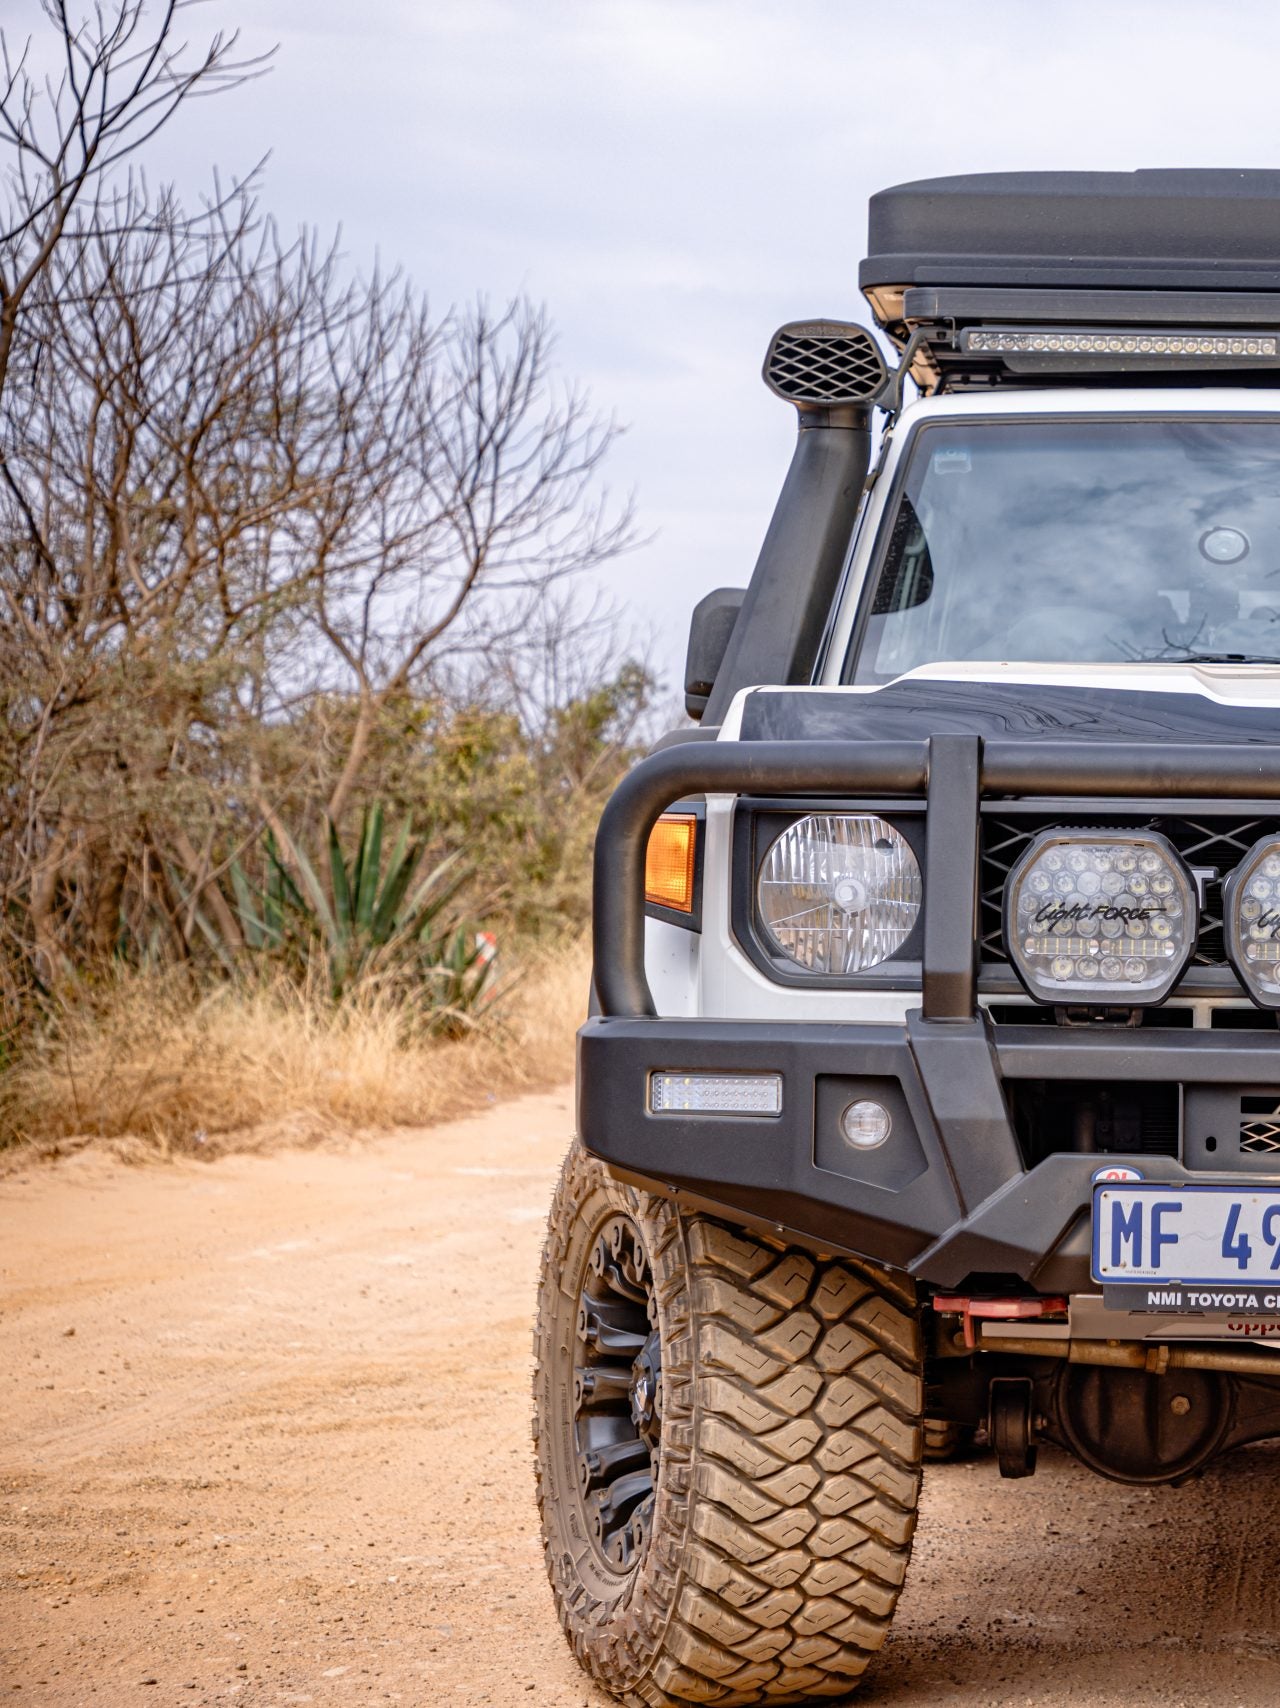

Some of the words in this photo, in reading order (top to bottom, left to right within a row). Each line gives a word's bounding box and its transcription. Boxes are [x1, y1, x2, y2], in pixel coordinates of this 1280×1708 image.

[1111, 1201, 1183, 1268] MF
[1147, 1291, 1182, 1306] NMI
[1187, 1293, 1259, 1308] TOYOTA
